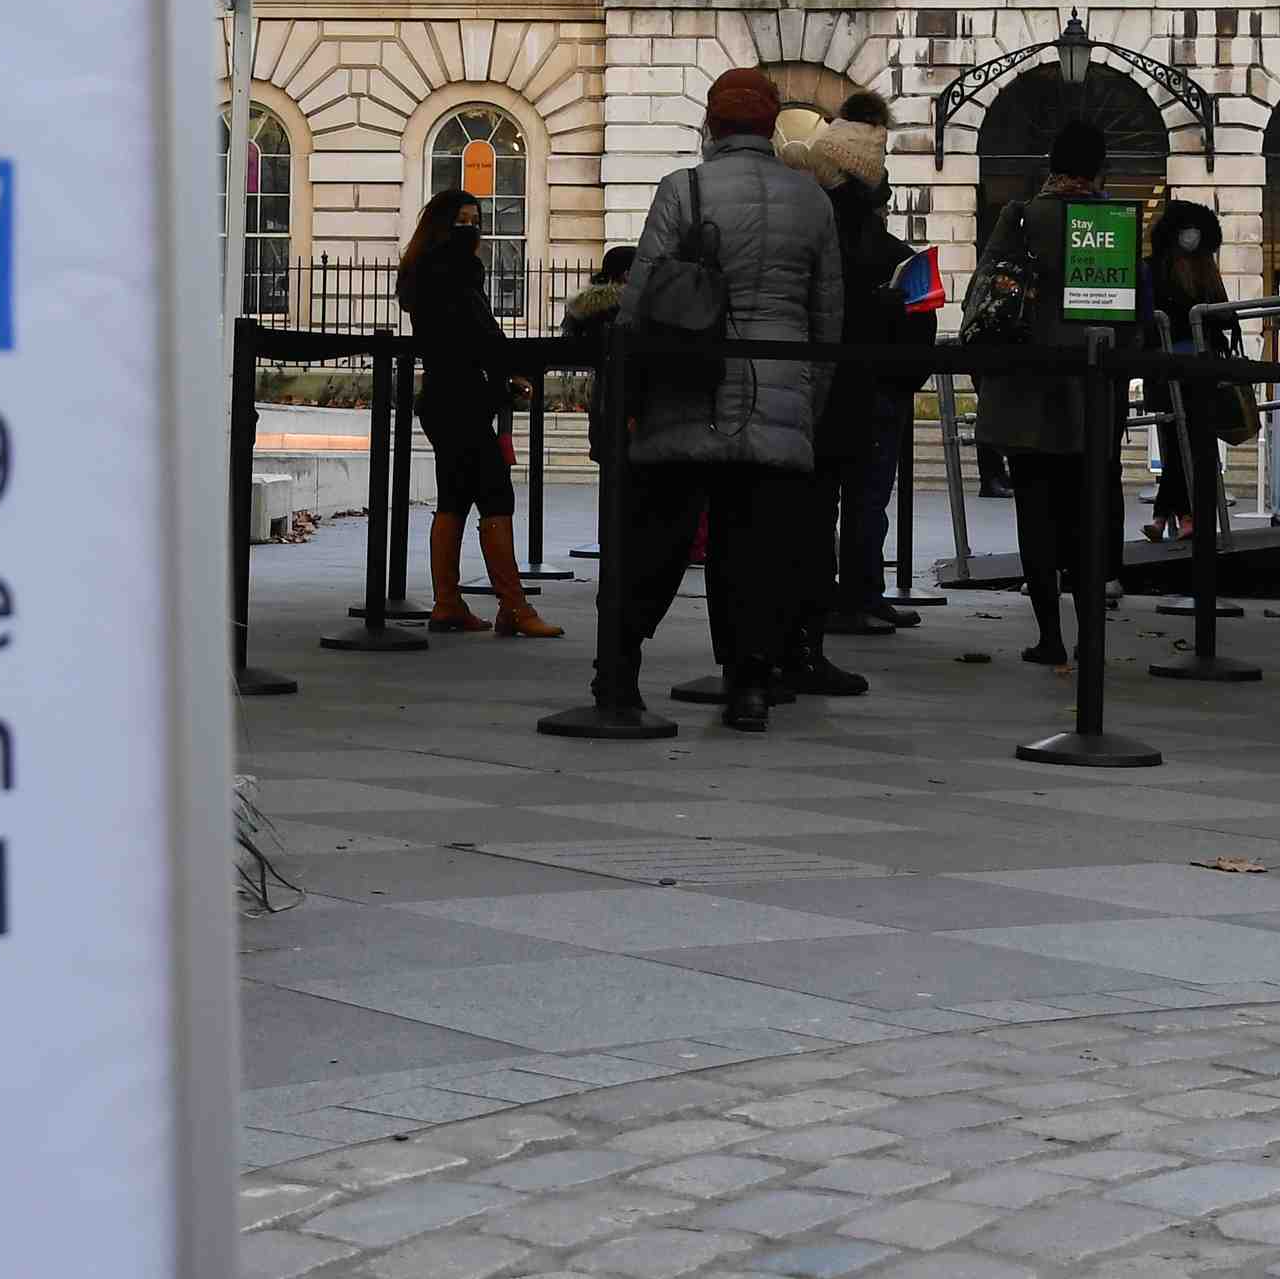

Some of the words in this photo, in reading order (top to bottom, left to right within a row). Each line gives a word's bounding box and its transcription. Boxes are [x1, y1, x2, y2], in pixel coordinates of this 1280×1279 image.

[1071, 219, 1094, 231] Stay
[1071, 231, 1115, 248] SAFE
[1070, 267, 1129, 283] APART
